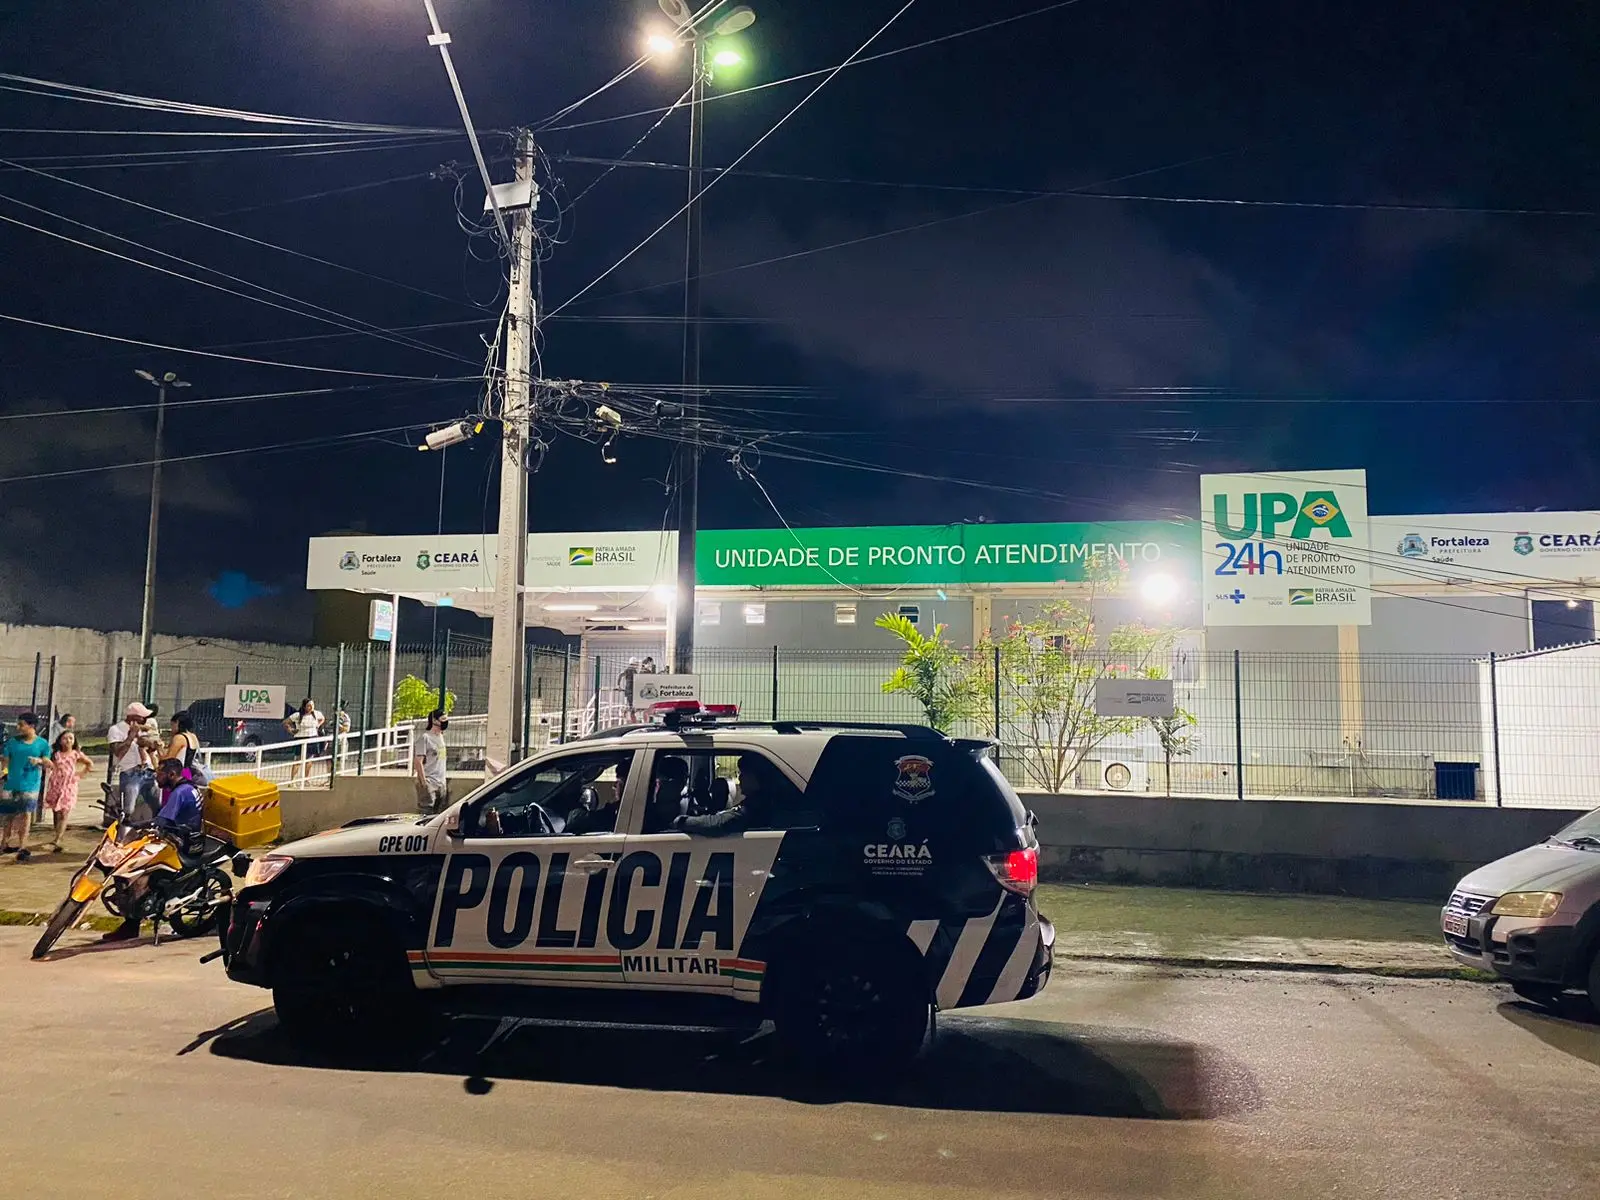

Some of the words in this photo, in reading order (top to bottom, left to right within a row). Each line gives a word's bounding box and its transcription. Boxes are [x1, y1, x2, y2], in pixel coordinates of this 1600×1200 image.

[1213, 490, 1352, 540] UPA
[1285, 542, 1329, 551] UNIDADE
[1431, 536, 1489, 547] Fortaleza
[361, 554, 402, 563] Fortaleza
[434, 549, 479, 563] CEARÁ
[595, 552, 635, 562] BRASIL
[715, 548, 819, 568] UNIDADE
[828, 547, 859, 566] DE
[868, 545, 965, 566] PRONTO
[974, 542, 1161, 565] ATENDIMENTO
[1214, 542, 1283, 576] 24h
[1286, 554, 1299, 563] DE
[1301, 552, 1341, 563] PRONTO
[1286, 564, 1356, 575] ATENDIMENTO
[1315, 592, 1357, 602] BRASIL
[239, 689, 271, 703] UPA
[379, 836, 403, 853] CPE
[405, 835, 429, 852] 001
[863, 838, 932, 858] CEARÁ
[623, 956, 719, 974] MILITAR
